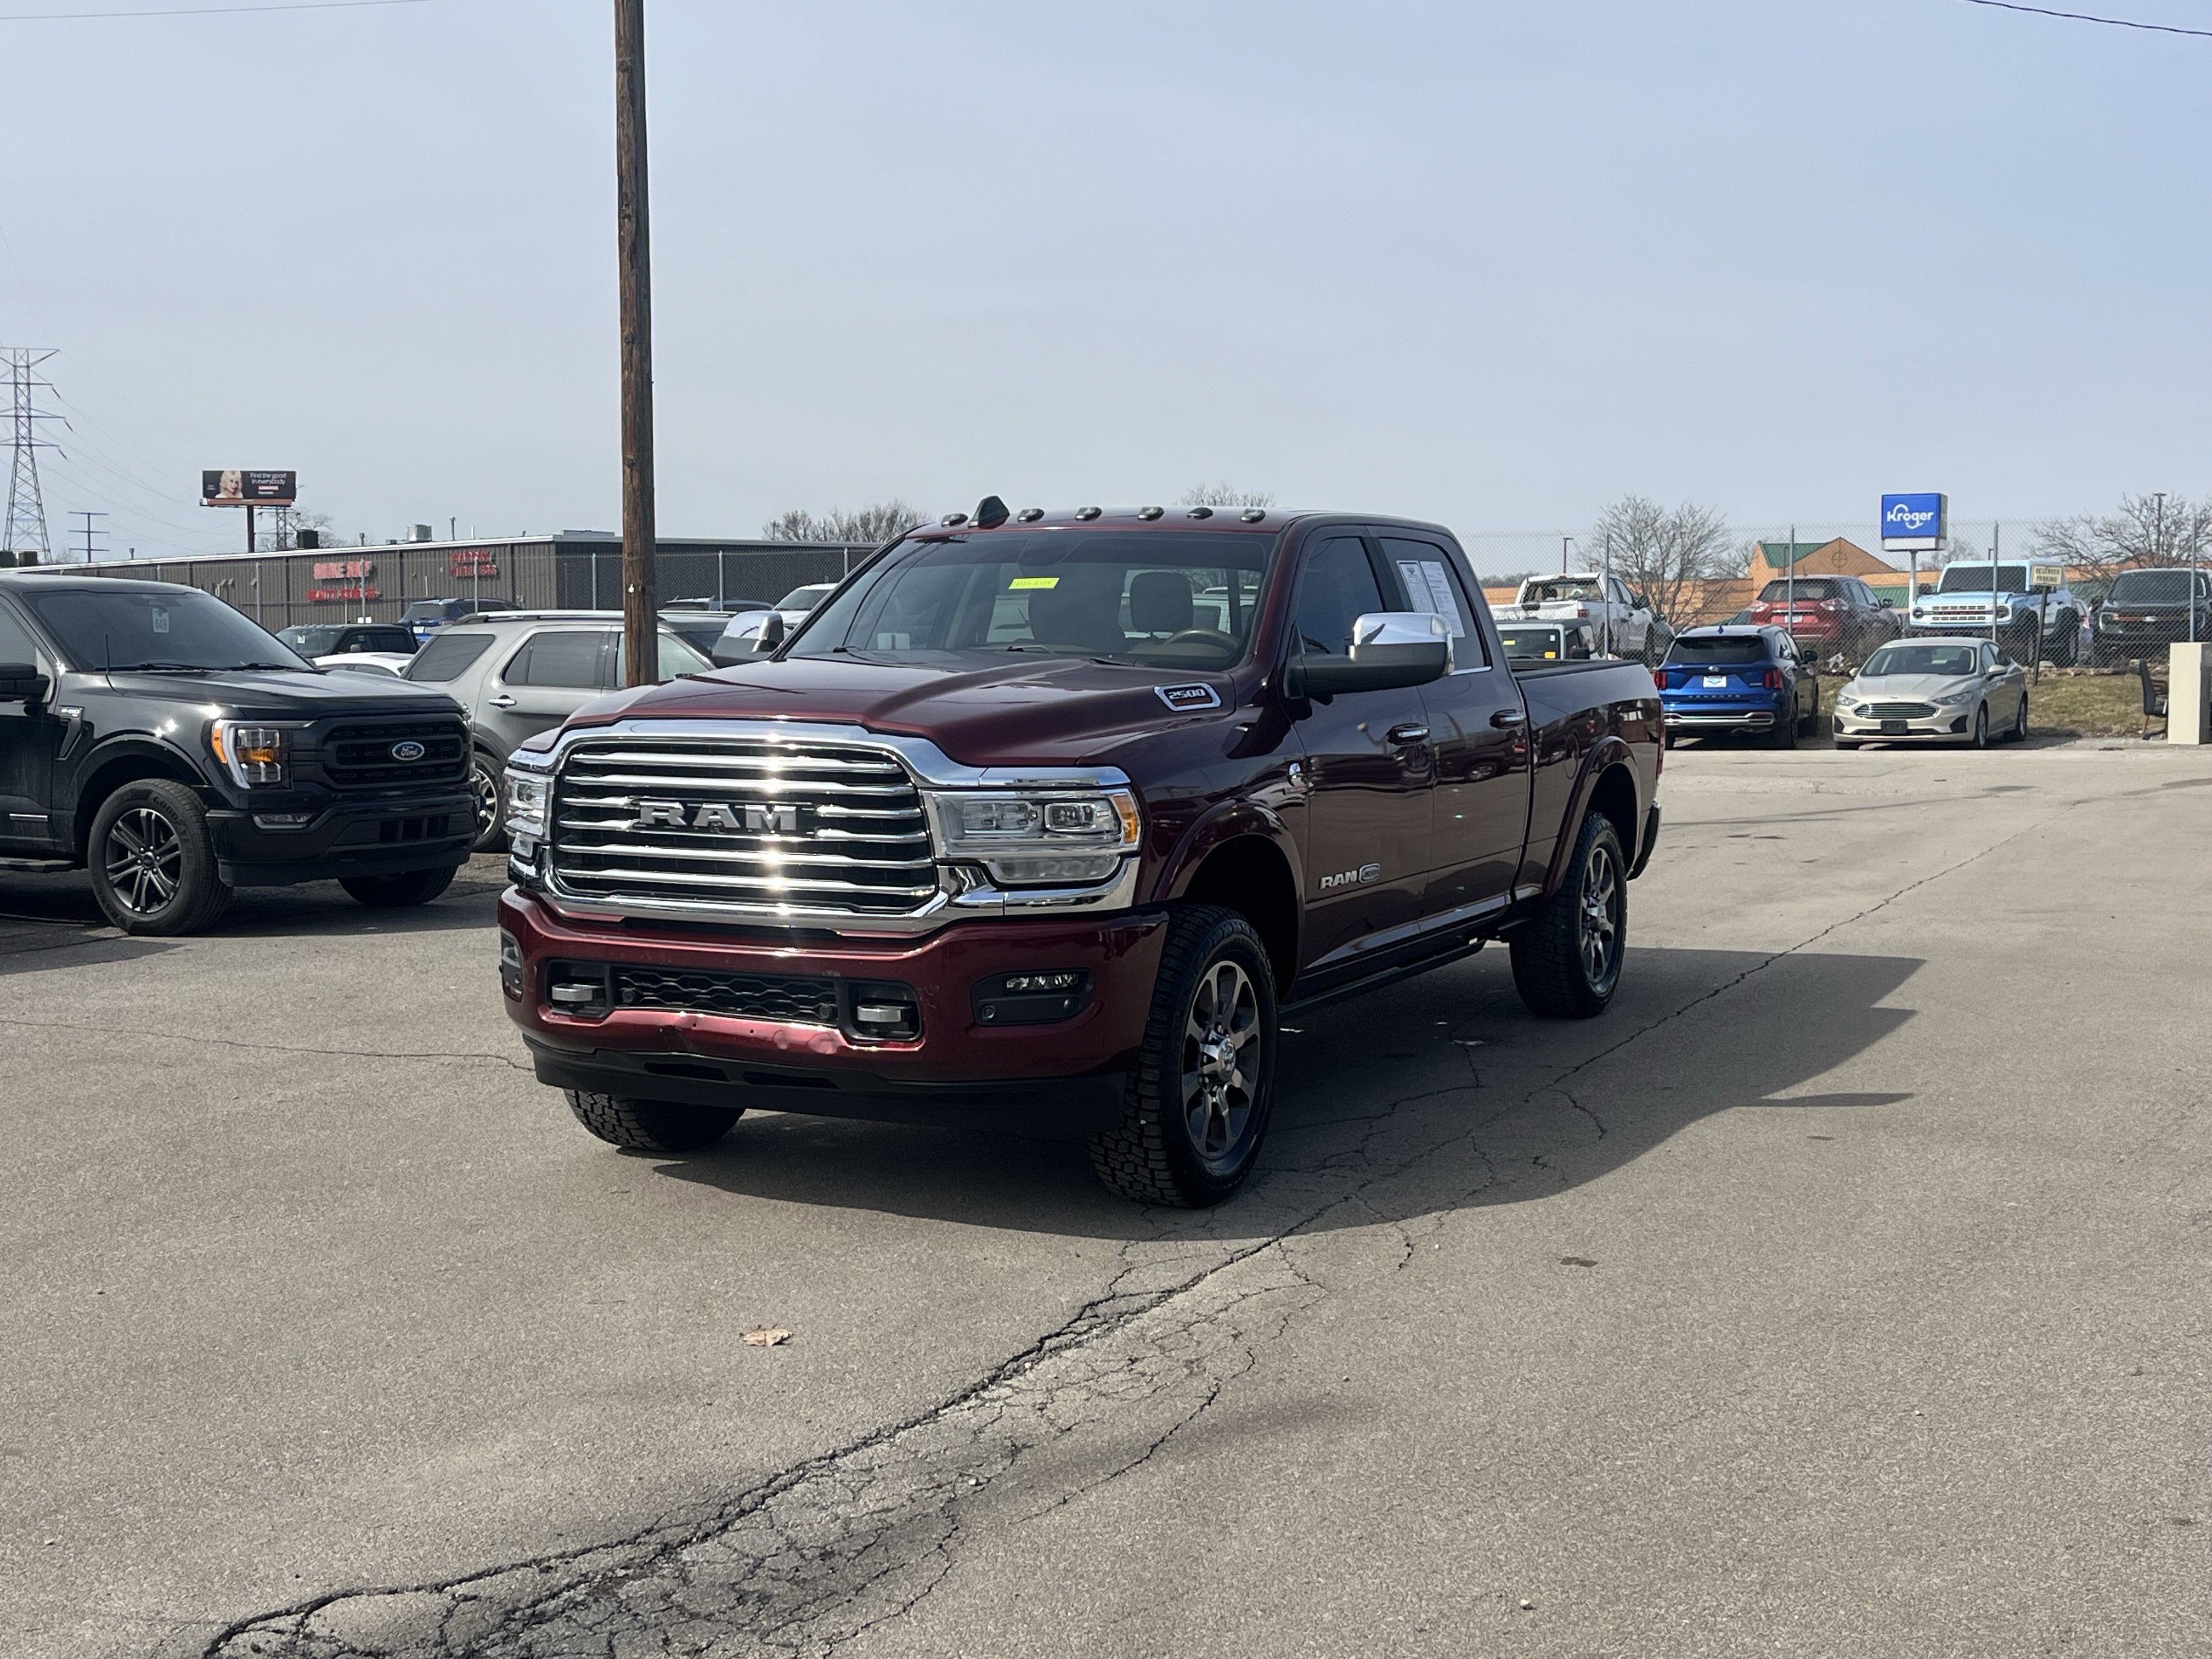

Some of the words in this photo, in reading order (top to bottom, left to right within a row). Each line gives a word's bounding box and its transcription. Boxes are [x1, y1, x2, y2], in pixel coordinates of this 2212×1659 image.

[1887, 504, 1934, 530] Kroger
[1167, 689, 1206, 700] 2500
[400, 745, 419, 757] Ford
[639, 802, 797, 831] RAM
[1320, 870, 1357, 889] RAM
